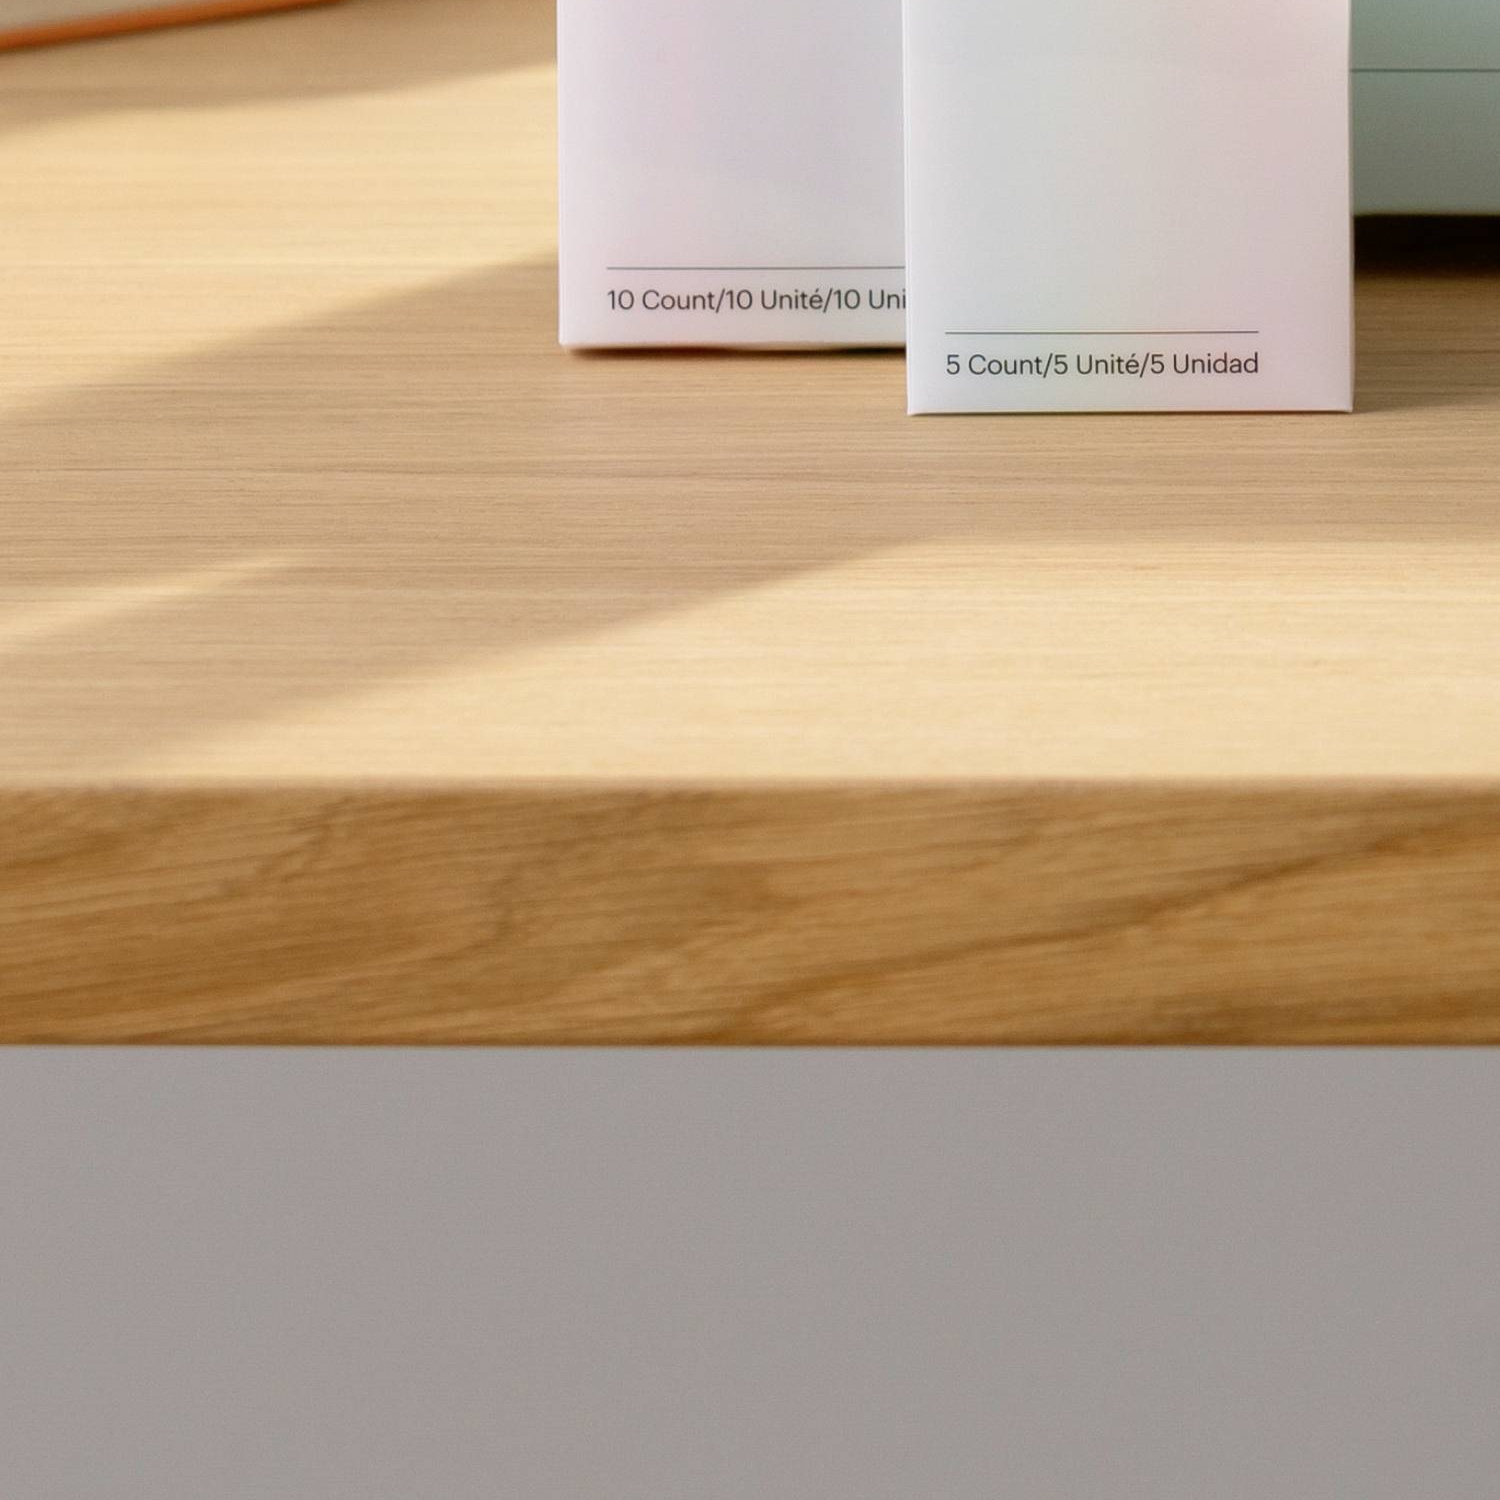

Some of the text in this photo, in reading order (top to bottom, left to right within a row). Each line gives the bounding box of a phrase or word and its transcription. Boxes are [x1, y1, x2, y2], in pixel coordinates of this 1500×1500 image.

[607, 287, 906, 314] 10 Count/10 Unité/10 Uni
[945, 350, 1259, 379] 5 Count/5 Unité/5 Unidad
